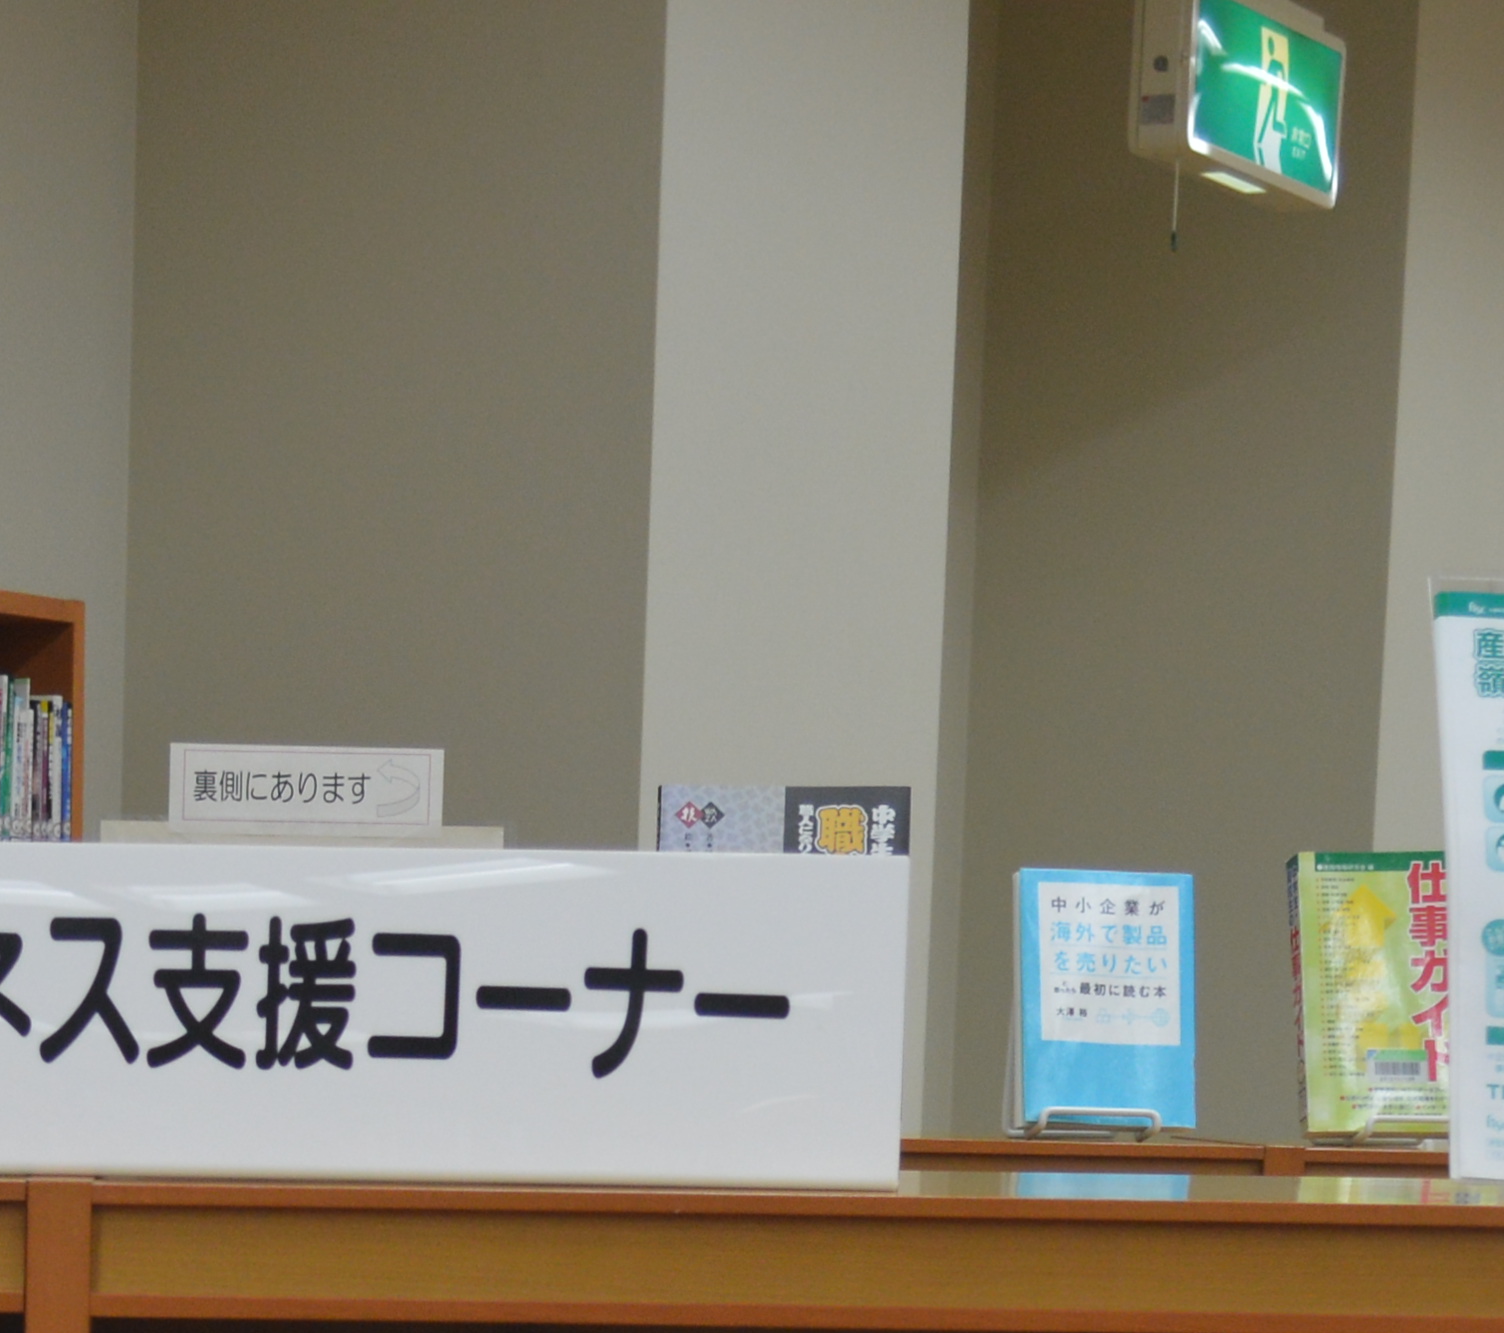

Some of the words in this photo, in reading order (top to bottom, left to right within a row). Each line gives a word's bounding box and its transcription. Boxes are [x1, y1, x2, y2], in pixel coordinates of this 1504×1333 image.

[1292, 147, 1306, 160] EXIT
[193, 770, 371, 804] 裏側にあります
[1051, 896, 1165, 918] 中小企業が
[1050, 921, 1168, 946] 海外で製品
[1053, 950, 1168, 975] を売りたい
[1079, 981, 1167, 999] 最初に読む本
